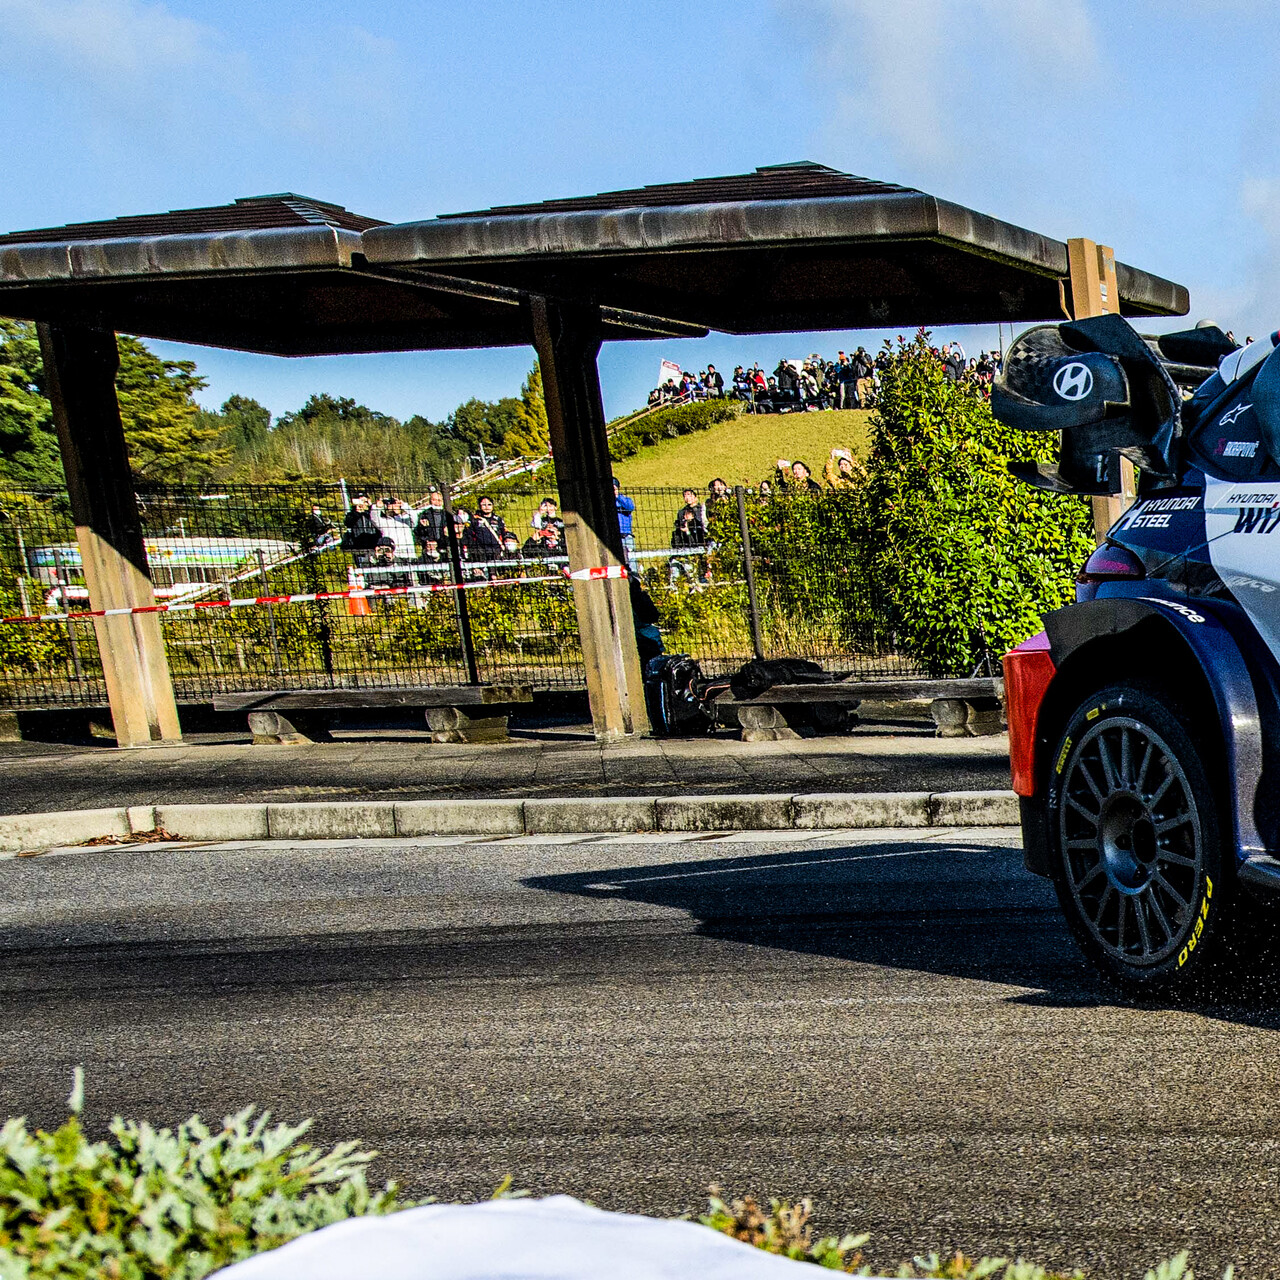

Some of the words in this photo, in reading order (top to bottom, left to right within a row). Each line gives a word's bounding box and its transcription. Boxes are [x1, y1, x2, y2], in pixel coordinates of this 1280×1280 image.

[1143, 496, 1202, 513] HYUNDAI
[1227, 493, 1279, 504] HYUNDAI
[1132, 514, 1173, 528] STEEL
